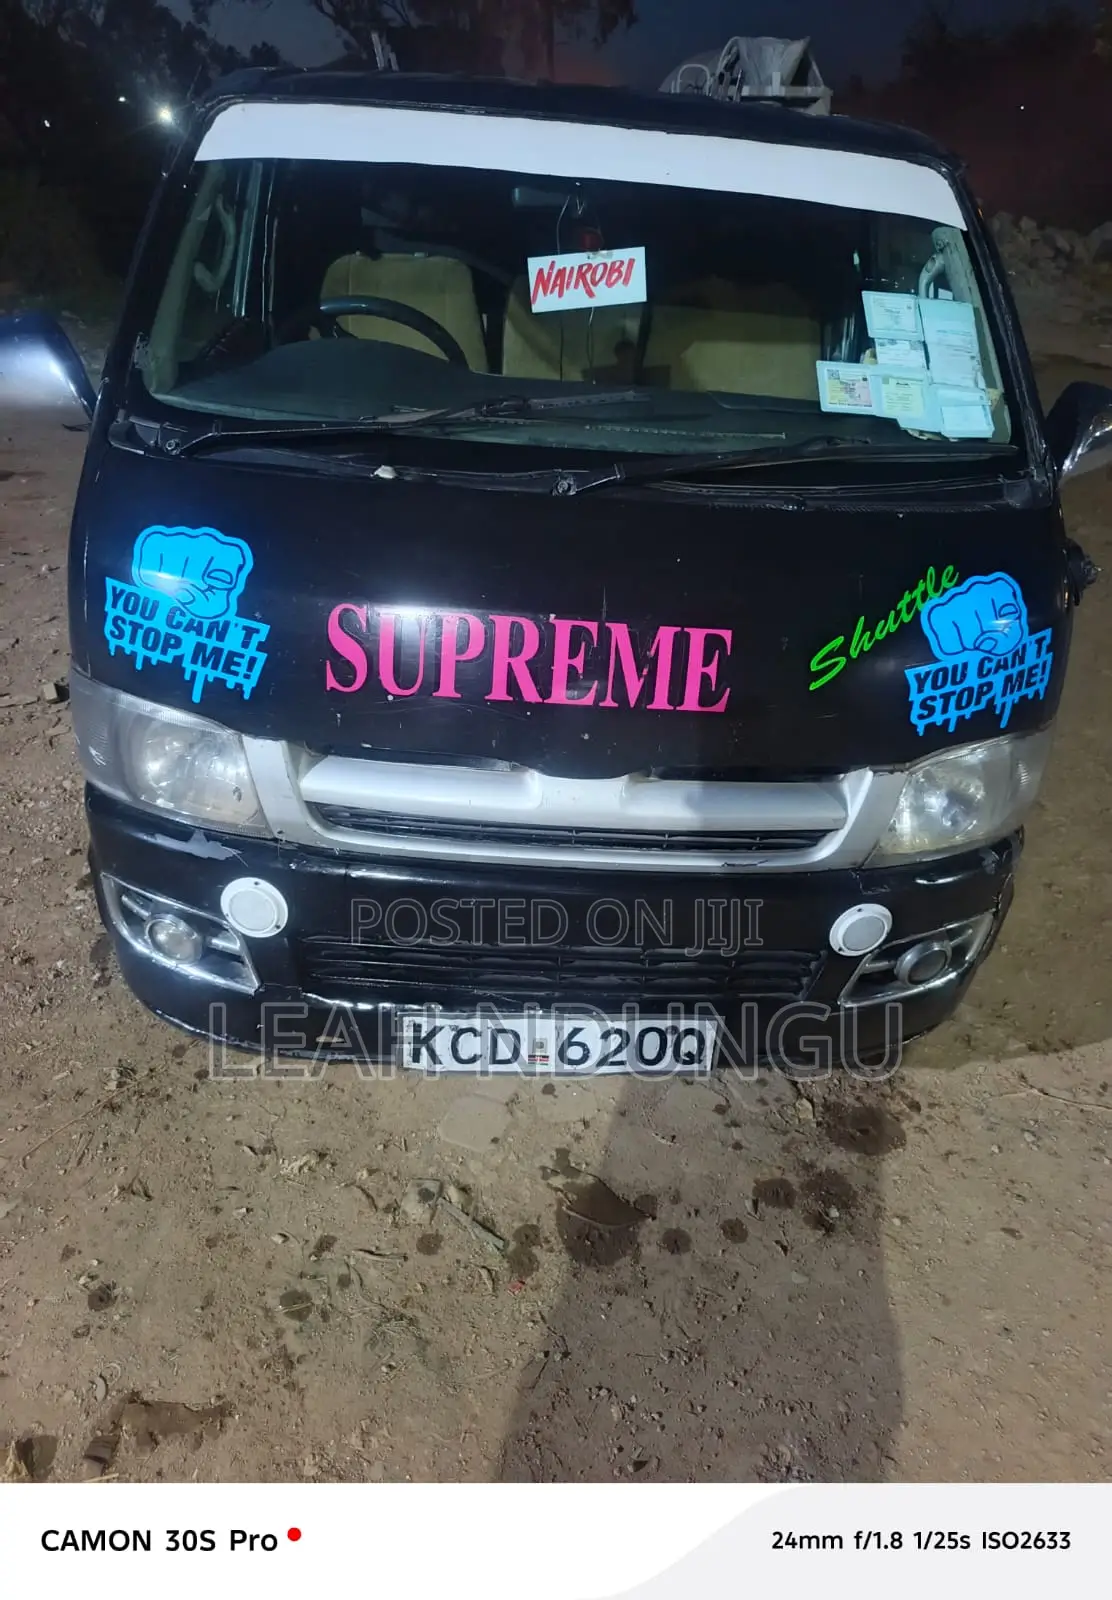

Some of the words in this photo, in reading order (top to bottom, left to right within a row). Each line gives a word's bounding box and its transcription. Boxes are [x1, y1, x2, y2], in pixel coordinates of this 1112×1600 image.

[531, 258, 636, 305] NAIROBI
[109, 585, 158, 620] YOU
[165, 605, 261, 649] CAN'T
[809, 565, 959, 691] Shuttle
[109, 618, 183, 656] STOP
[190, 643, 258, 679] ME!
[325, 603, 733, 713] SUPREME
[914, 661, 968, 695] YOU
[976, 635, 1048, 680] CAN'T
[918, 681, 993, 721] STOP
[1001, 659, 1048, 697] ME!
[411, 1022, 521, 1066] KCD
[557, 1026, 706, 1067] 620Q
